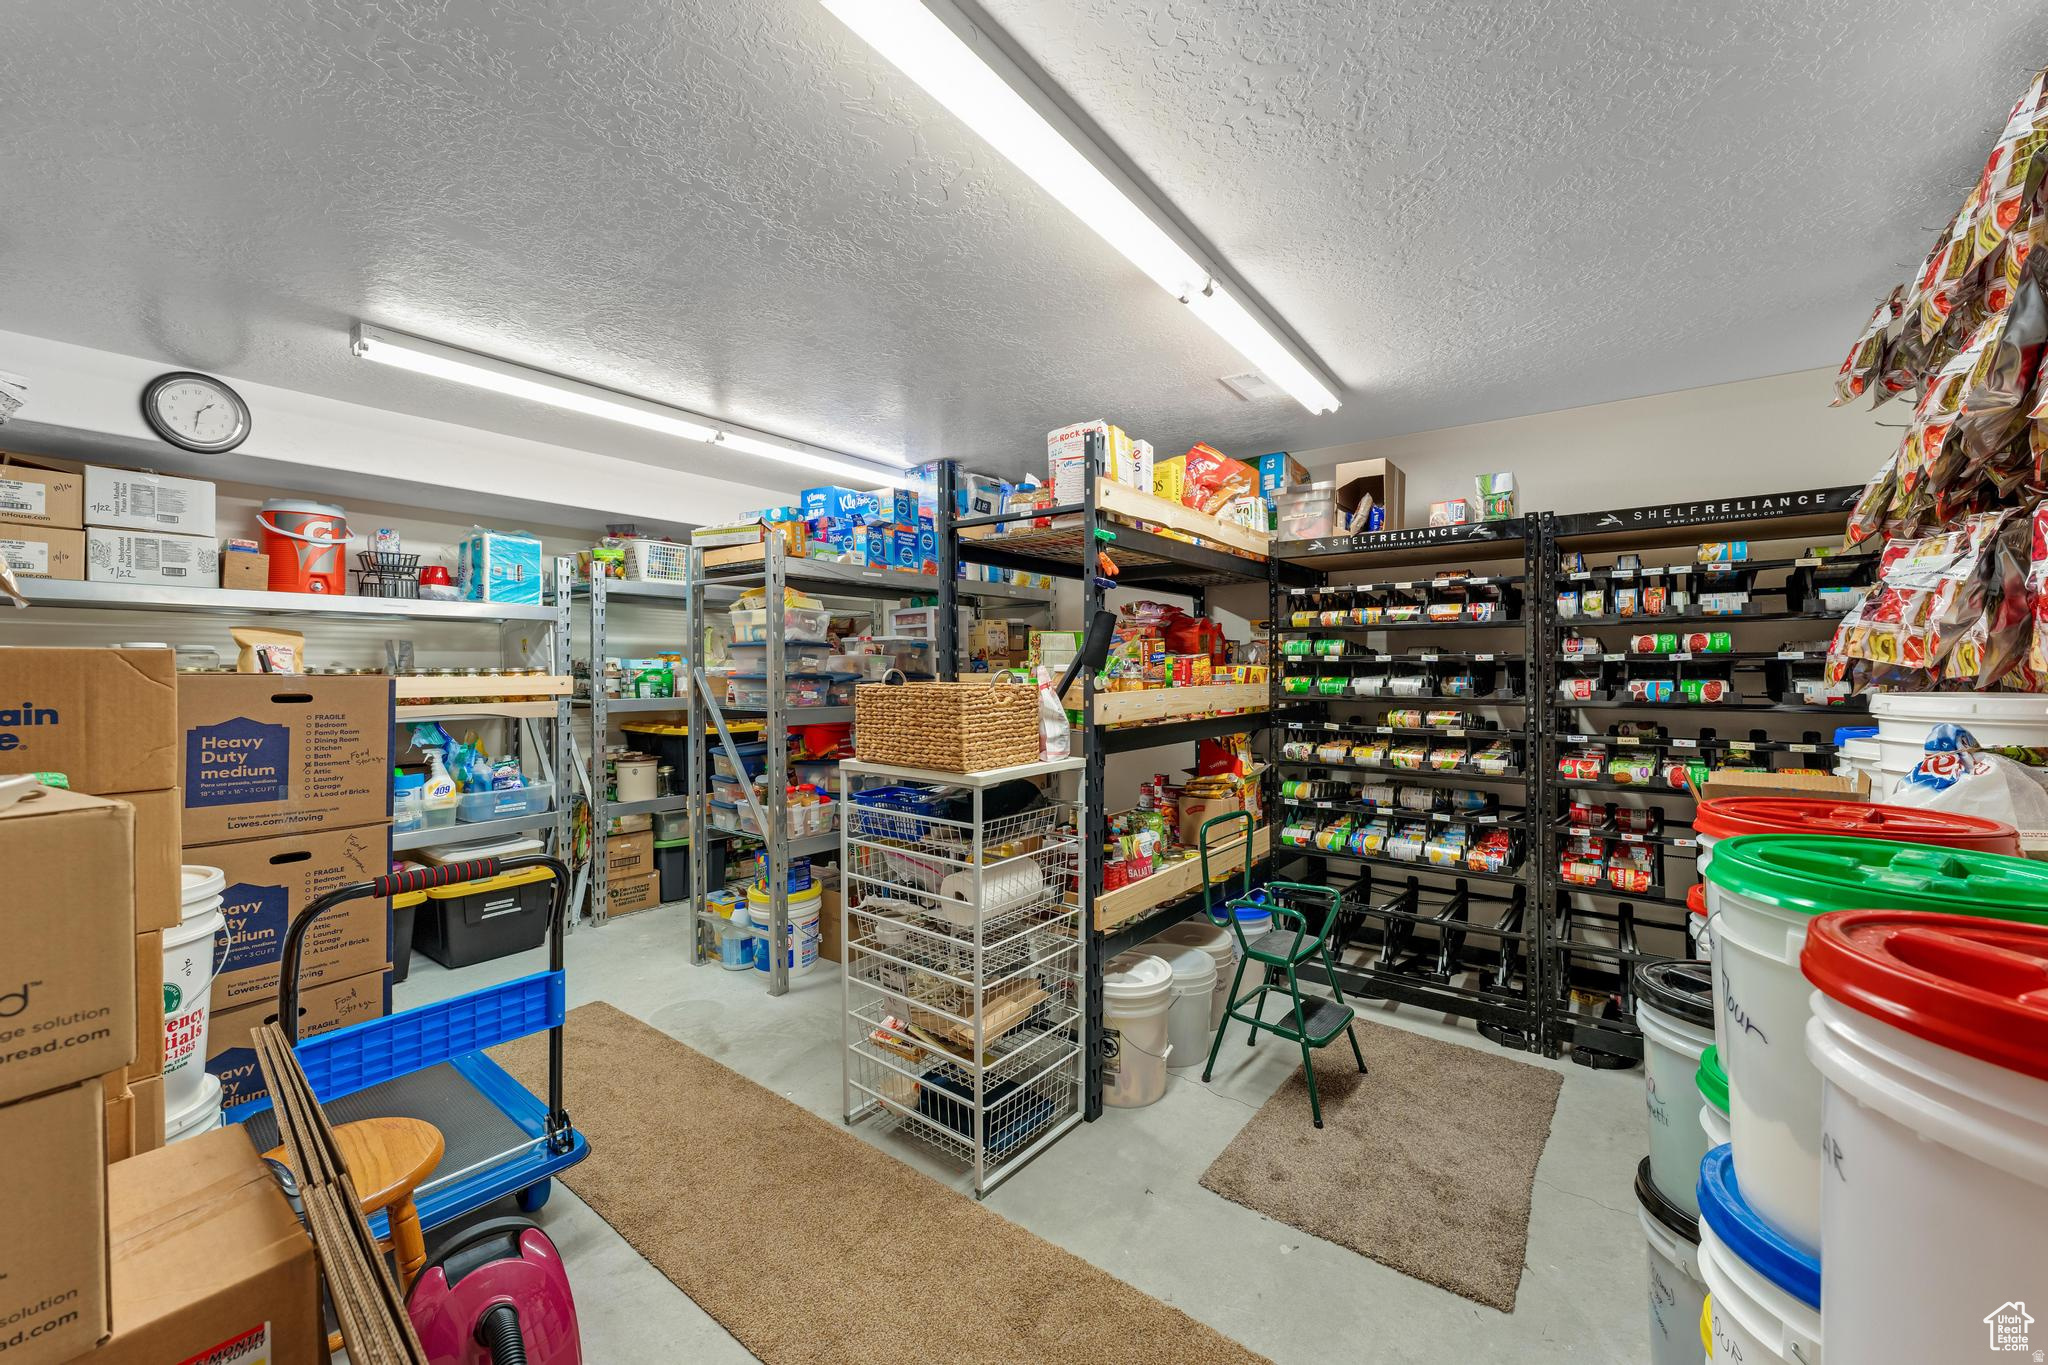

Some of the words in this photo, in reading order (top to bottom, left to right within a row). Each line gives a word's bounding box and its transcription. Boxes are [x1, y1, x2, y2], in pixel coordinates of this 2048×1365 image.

[13, 571, 53, 580] ouse.com
[201, 736, 264, 750] Heavy
[201, 751, 248, 765] Duty
[201, 765, 275, 780] medium
[313, 775, 343, 783] Laundry
[313, 783, 341, 791] Garage
[349, 787, 370, 795] Bricks
[433, 784, 450, 797] 409
[227, 814, 324, 829] Lowes.com/Moving
[314, 867, 345, 877] FRAGILE
[314, 874, 346, 884] Bedroom
[314, 884, 337, 892] Family
[221, 901, 263, 916] eavy
[313, 923, 331, 931] Attic
[313, 928, 343, 938] Laundry
[313, 936, 341, 945] Garage
[320, 943, 339, 952] Load
[340, 941, 347, 949] of
[348, 937, 369, 947] Bricks
[32, 1007, 110, 1033] solution
[308, 1018, 340, 1033] FRAGILE
[165, 1025, 203, 1051] tials
[162, 1061, 188, 1075] red.com
[219, 1062, 256, 1080] avy
[223, 1088, 269, 1109] dium
